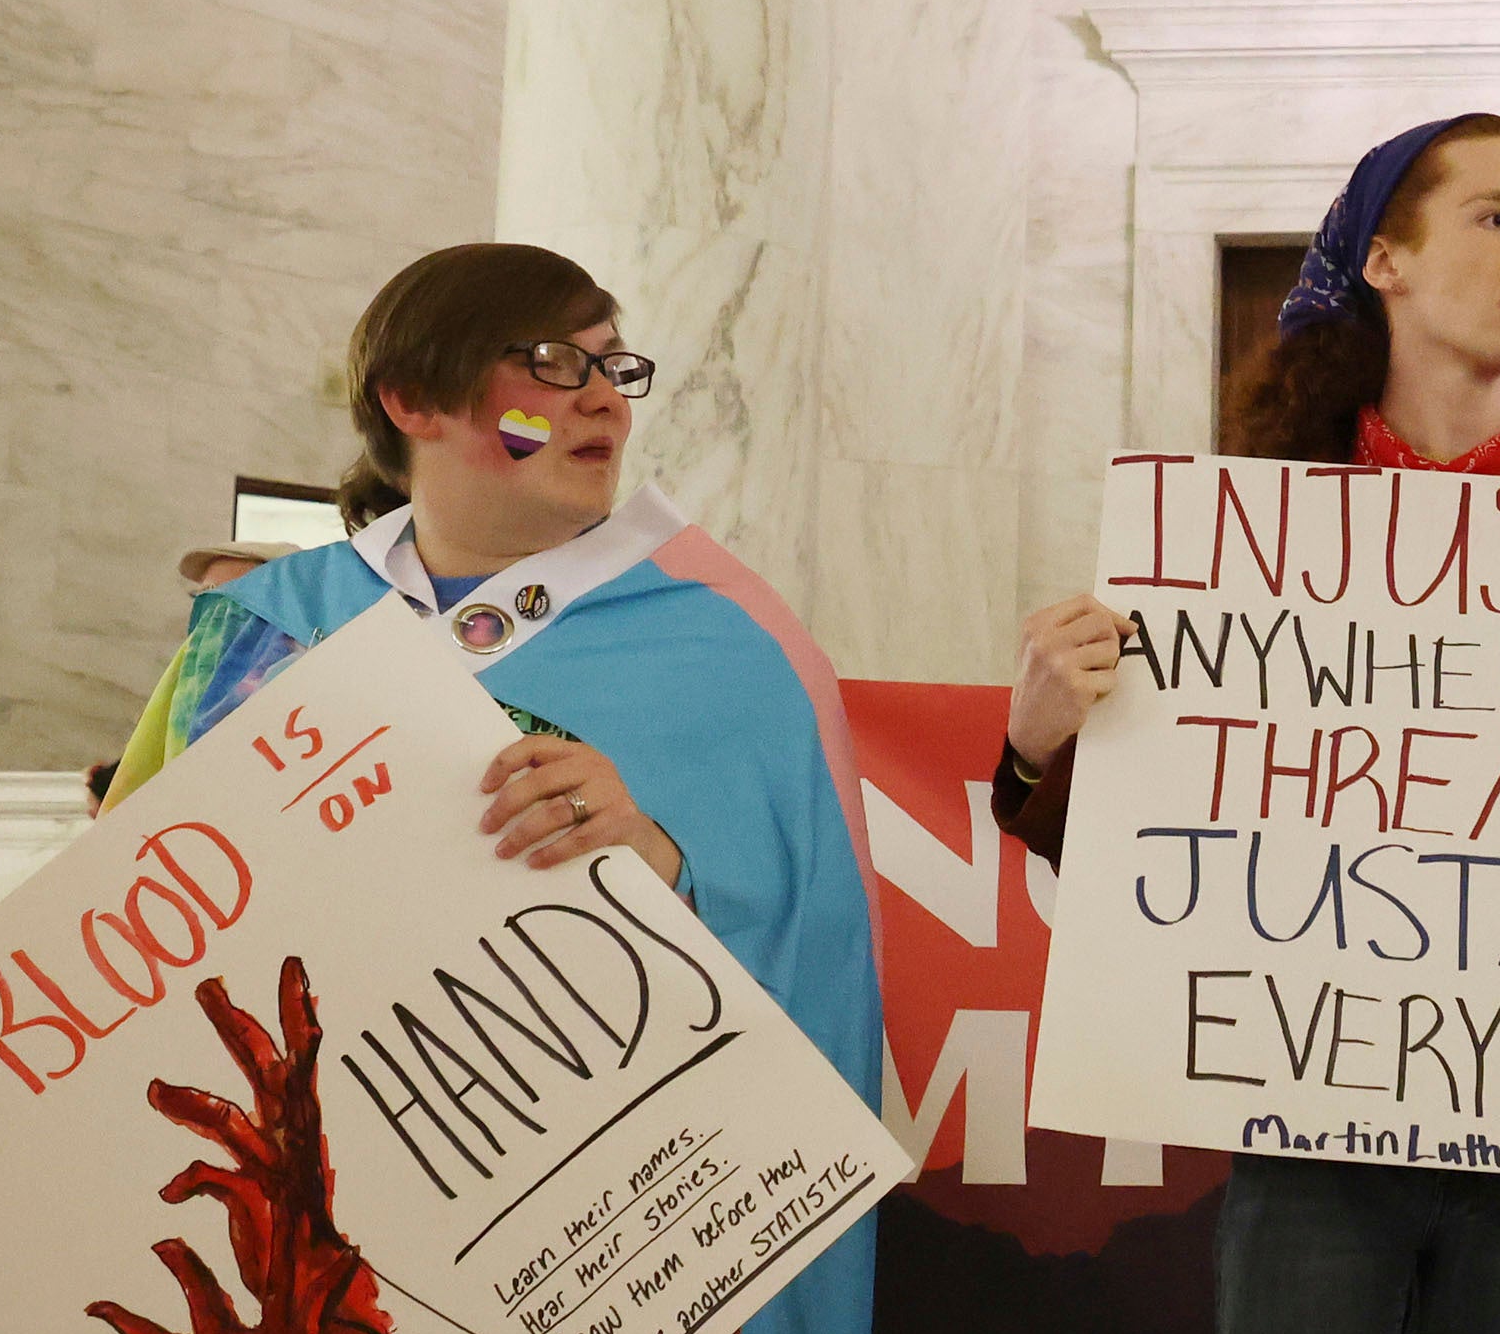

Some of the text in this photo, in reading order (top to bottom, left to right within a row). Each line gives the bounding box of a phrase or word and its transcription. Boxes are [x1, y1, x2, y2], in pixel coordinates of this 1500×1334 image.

[251, 705, 325, 773] IS
[318, 762, 392, 833] ON
[341, 854, 740, 1201] HANDS
[1242, 1114, 1399, 1155] Martin
[494, 1127, 705, 1305] Learn their names.
[575, 1232, 623, 1287] their
[627, 1253, 684, 1307] them
[692, 1192, 757, 1248] before
[761, 1148, 804, 1196] they
[677, 1258, 744, 1330] another
[750, 1153, 868, 1258] STATISTIC.
